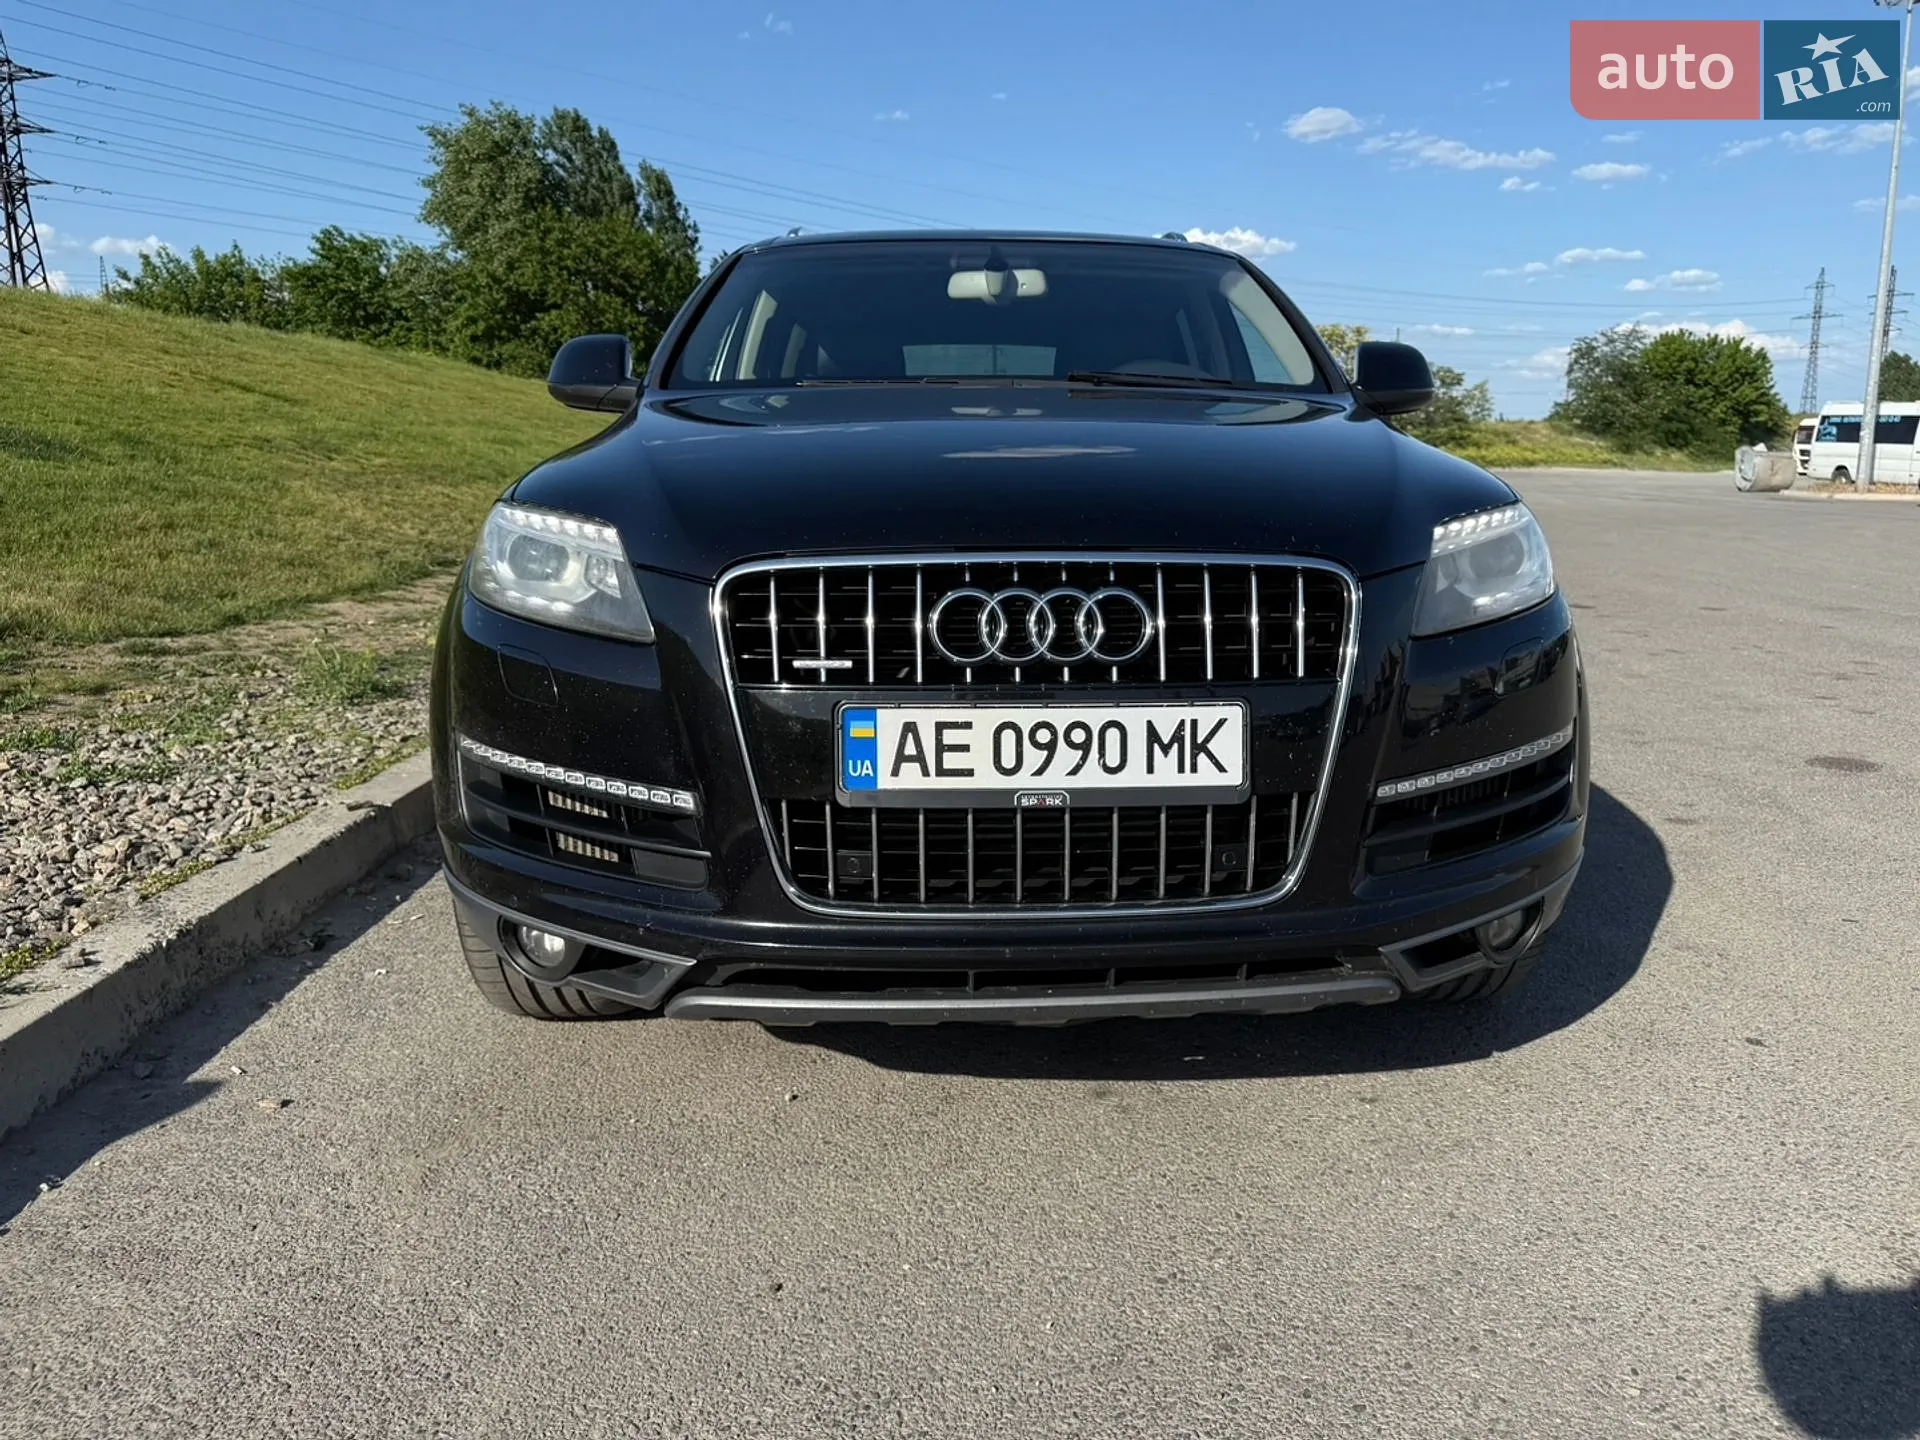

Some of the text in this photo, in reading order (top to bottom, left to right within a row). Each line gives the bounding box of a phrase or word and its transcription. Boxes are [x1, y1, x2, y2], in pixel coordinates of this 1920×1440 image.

[890, 717, 1229, 778] AE 0990 MK
[848, 760, 874, 777] UA
[1021, 798, 1063, 806] SPARK
